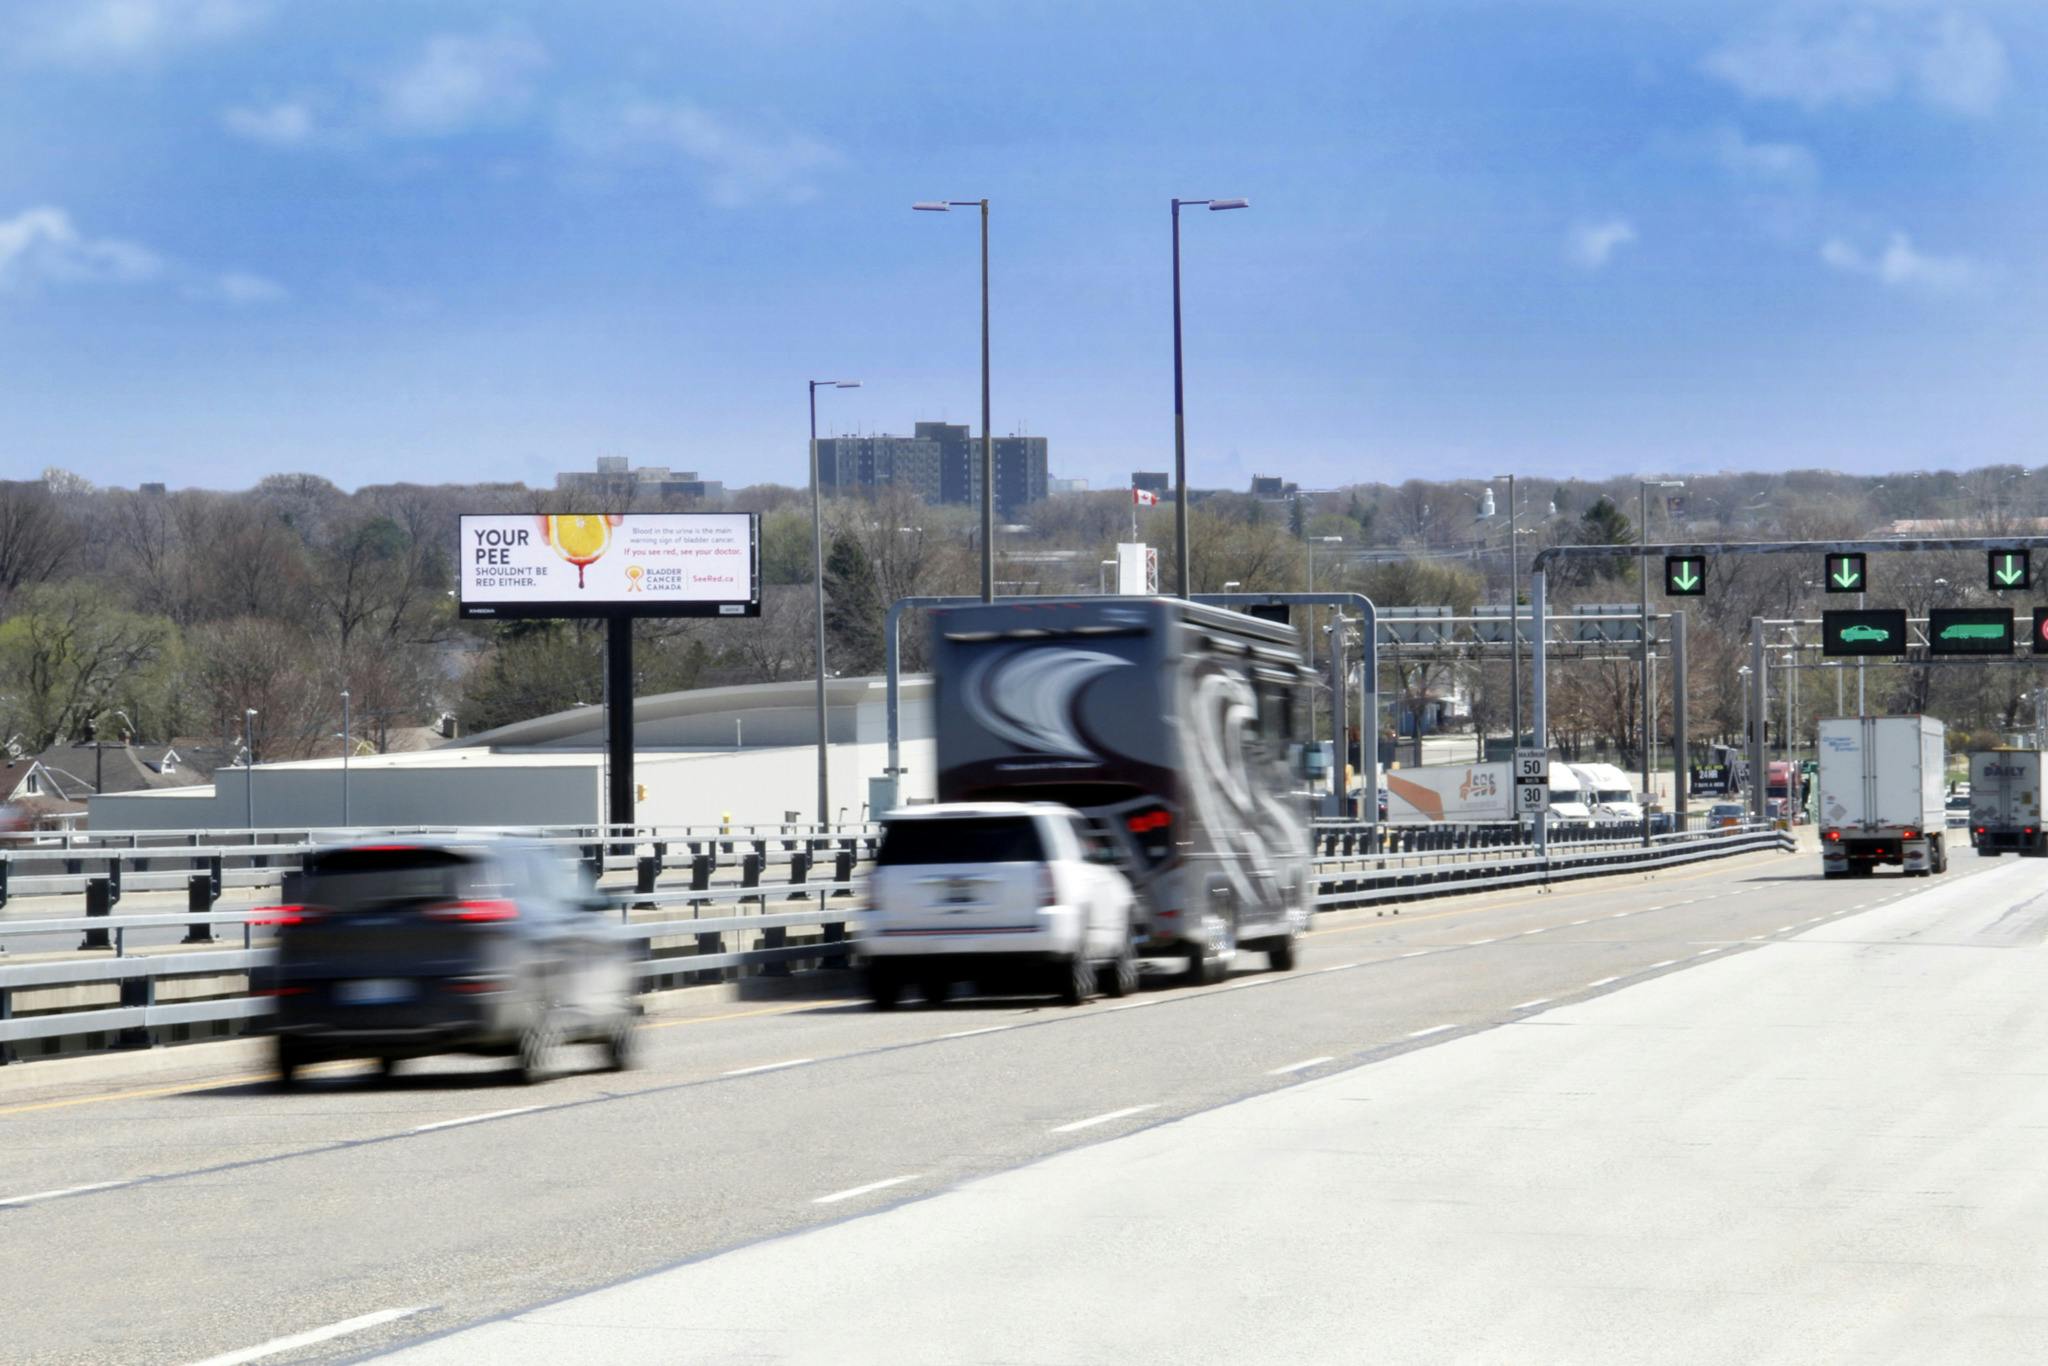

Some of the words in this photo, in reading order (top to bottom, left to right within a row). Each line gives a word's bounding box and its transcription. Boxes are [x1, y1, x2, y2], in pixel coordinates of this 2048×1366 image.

[632, 527, 653, 535] Blood
[655, 527, 661, 535] in
[662, 527, 674, 535] the
[675, 527, 693, 535] urine
[702, 527, 714, 535] the
[715, 527, 732, 535] main
[474, 529, 529, 546] YOUR
[475, 548, 510, 565] PEE
[624, 548, 631, 556] If
[632, 549, 646, 557] you
[663, 548, 679, 557] red,
[695, 549, 712, 557] your
[713, 547, 741, 555] doctor.
[475, 567, 532, 576] SHOULDN'T
[535, 567, 548, 576] BE
[475, 578, 496, 587] RED
[498, 578, 537, 587] EITHER.
[692, 574, 734, 583] SeeRed.ca
[1523, 760, 1541, 774] 50
[1984, 766, 2026, 776] DAILY
[1524, 787, 1541, 802] 30
